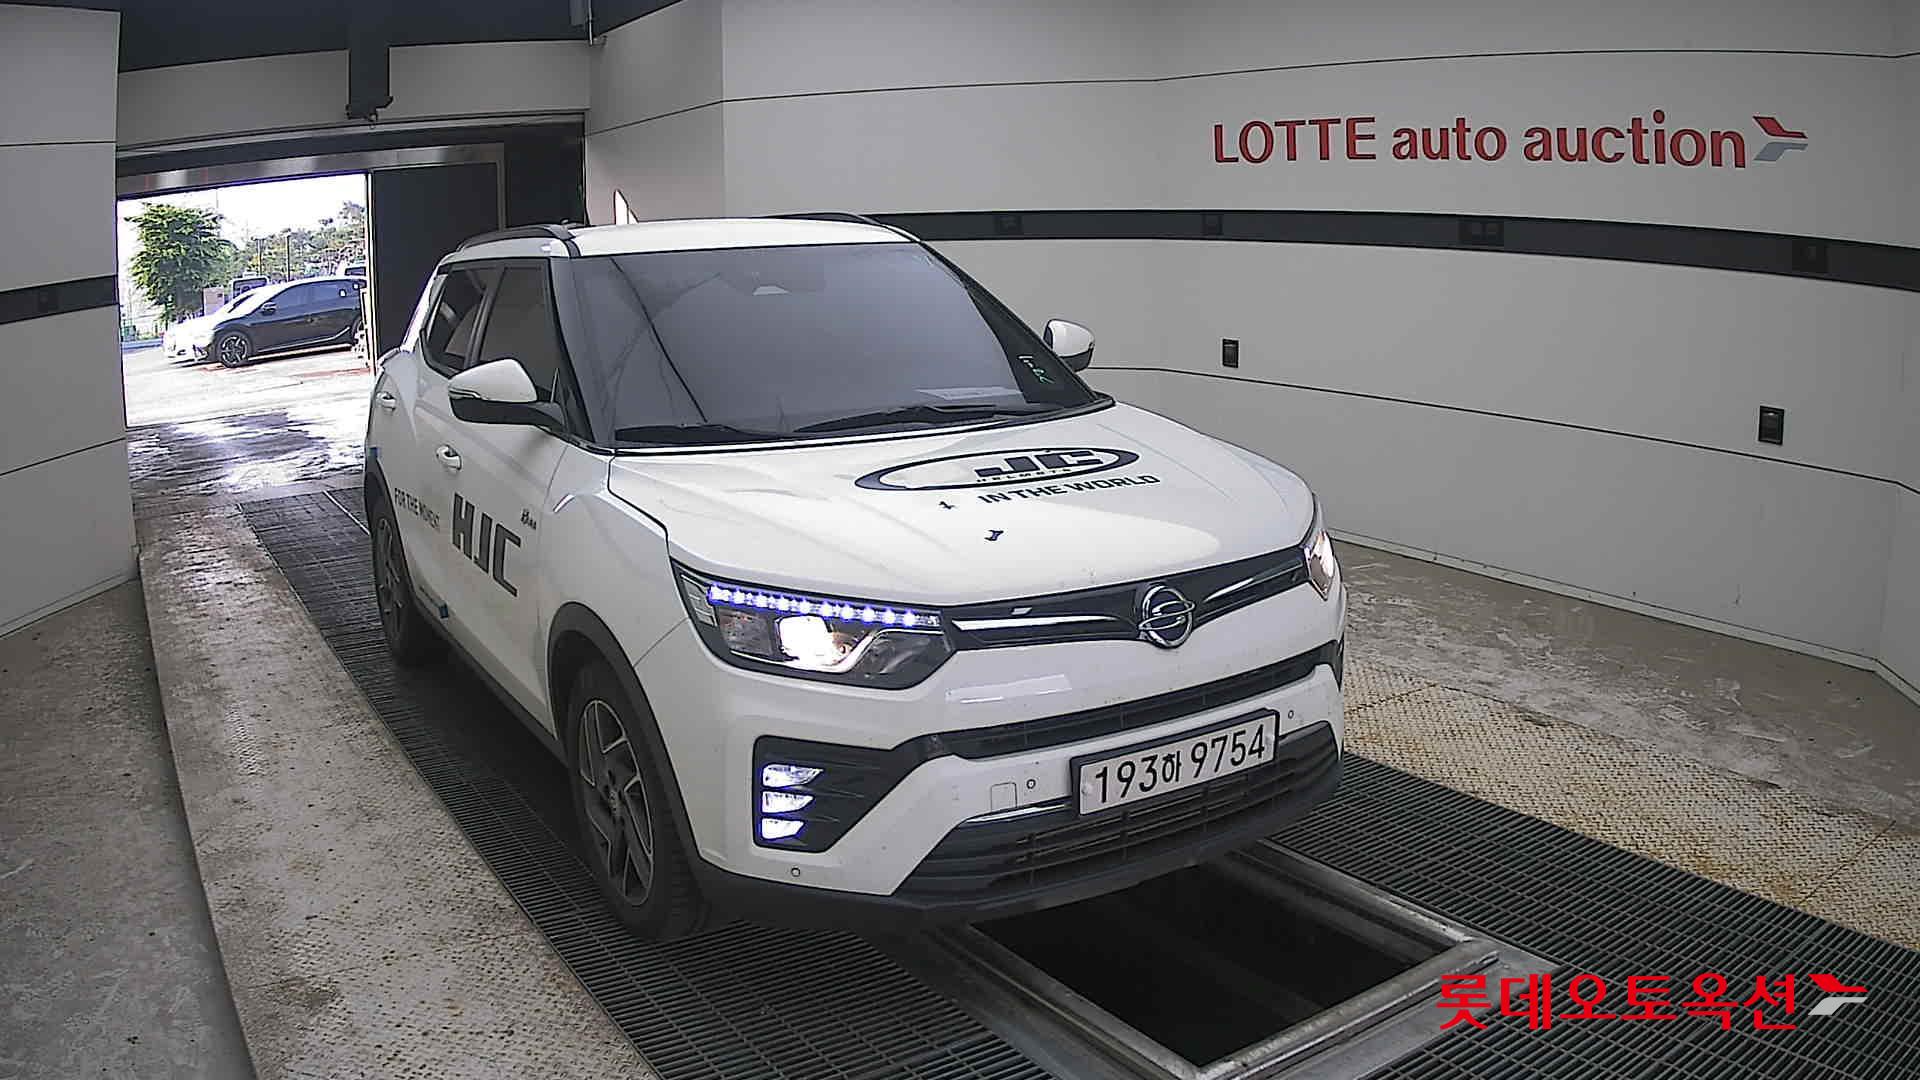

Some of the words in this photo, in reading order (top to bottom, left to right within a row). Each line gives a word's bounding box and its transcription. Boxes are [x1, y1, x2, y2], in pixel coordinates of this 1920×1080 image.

[1213, 116, 1376, 164] LOTTE
[1392, 117, 1507, 161] auto
[1523, 109, 1748, 169] auction
[977, 492, 1011, 504] IN
[1007, 484, 1068, 499] THE
[1064, 475, 1161, 491] WORLD
[452, 492, 521, 597] HJC
[1095, 750, 1182, 803] 193하
[1190, 724, 1265, 779] 9754
